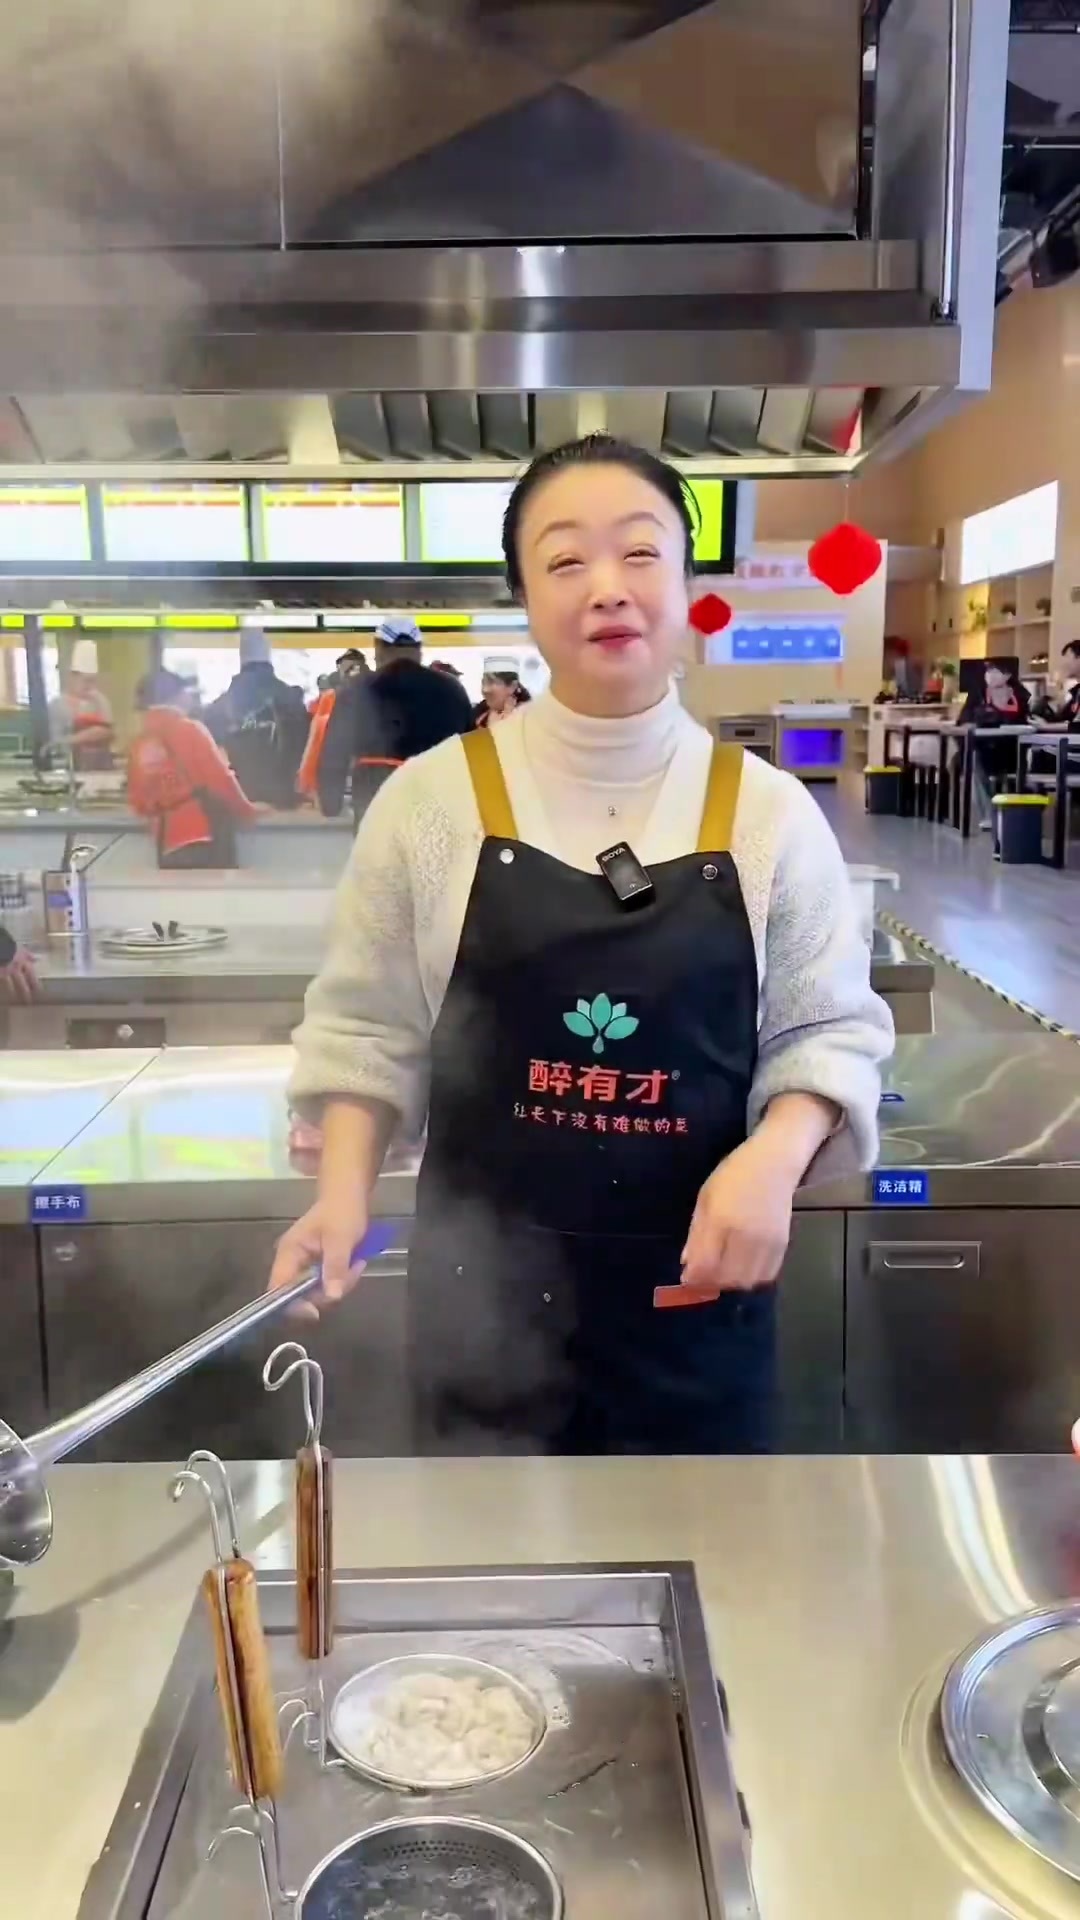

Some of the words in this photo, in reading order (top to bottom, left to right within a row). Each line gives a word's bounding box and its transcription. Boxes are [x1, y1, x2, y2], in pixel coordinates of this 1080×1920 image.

[601, 847, 626, 862] BOYA
[878, 1179, 923, 1193] 洗洁精
